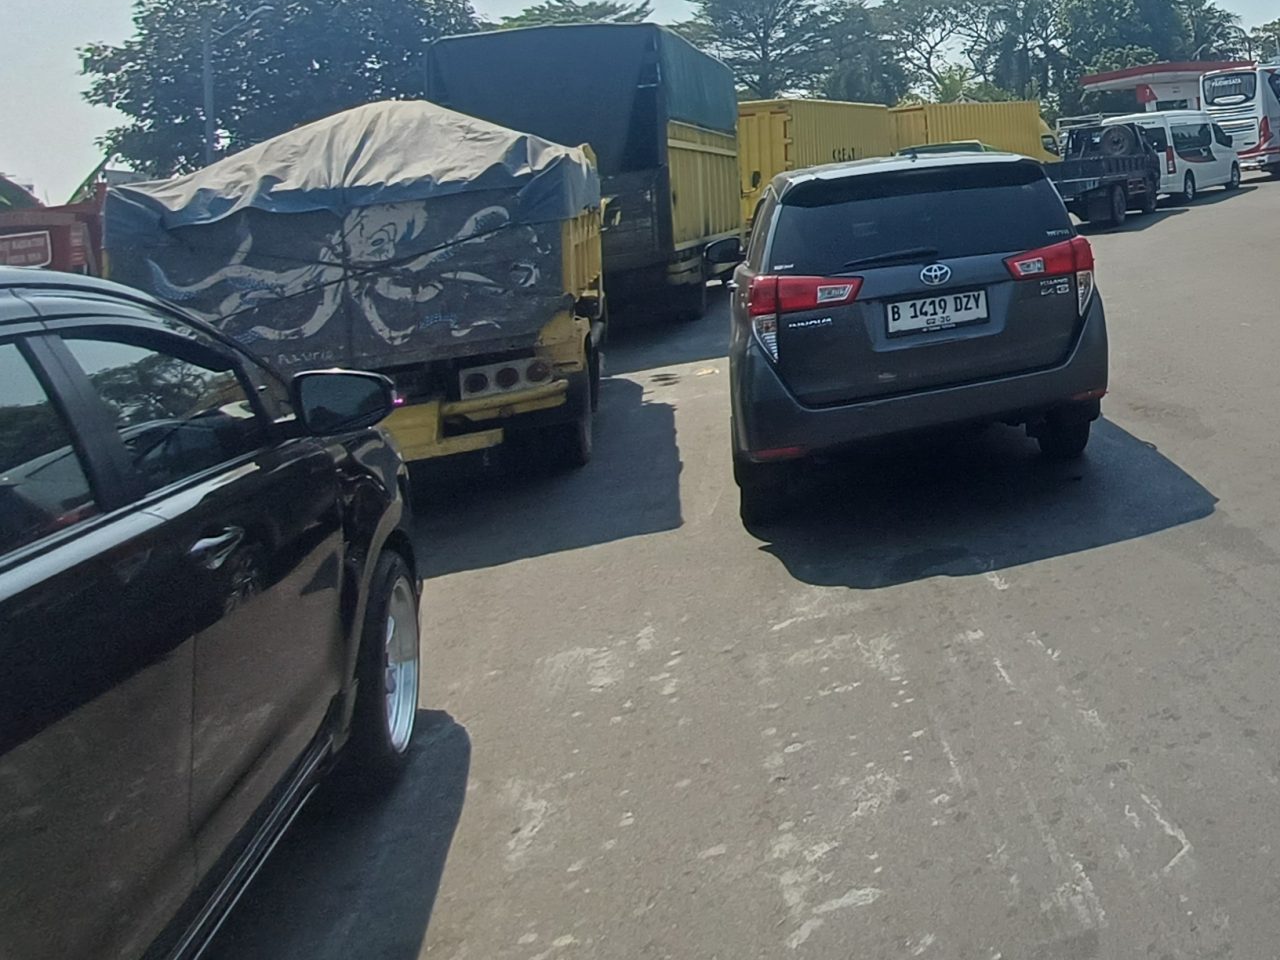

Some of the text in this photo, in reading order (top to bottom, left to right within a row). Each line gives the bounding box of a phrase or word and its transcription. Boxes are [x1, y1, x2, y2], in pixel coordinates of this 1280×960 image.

[891, 292, 981, 322] B 1419 DZY
